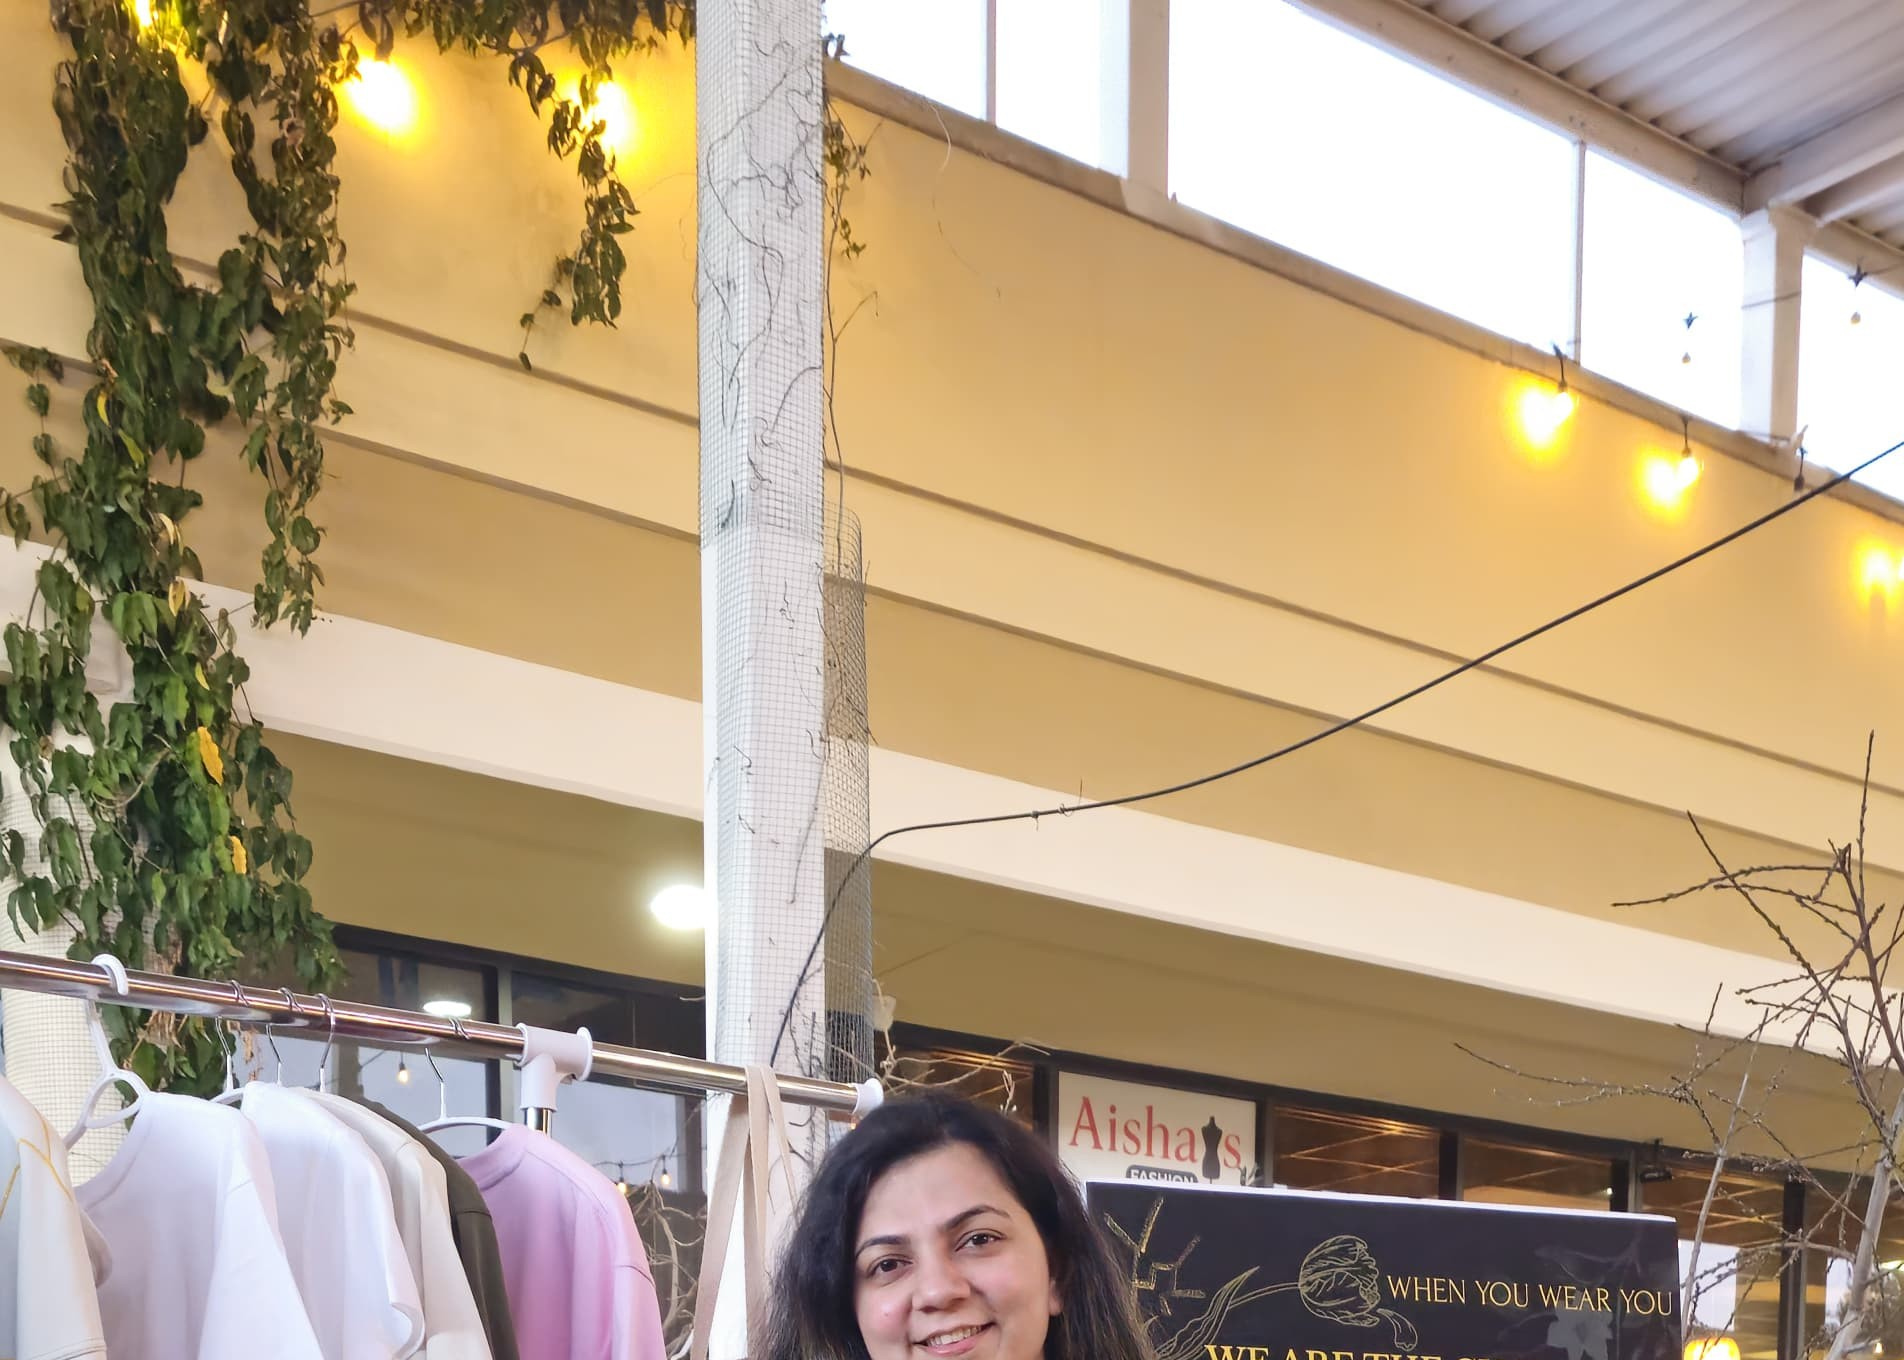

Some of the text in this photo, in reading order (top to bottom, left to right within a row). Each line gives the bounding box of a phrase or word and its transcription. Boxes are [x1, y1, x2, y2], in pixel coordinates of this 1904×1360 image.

[1387, 1275, 1672, 1316] WHEN YOU WEAR YOU
